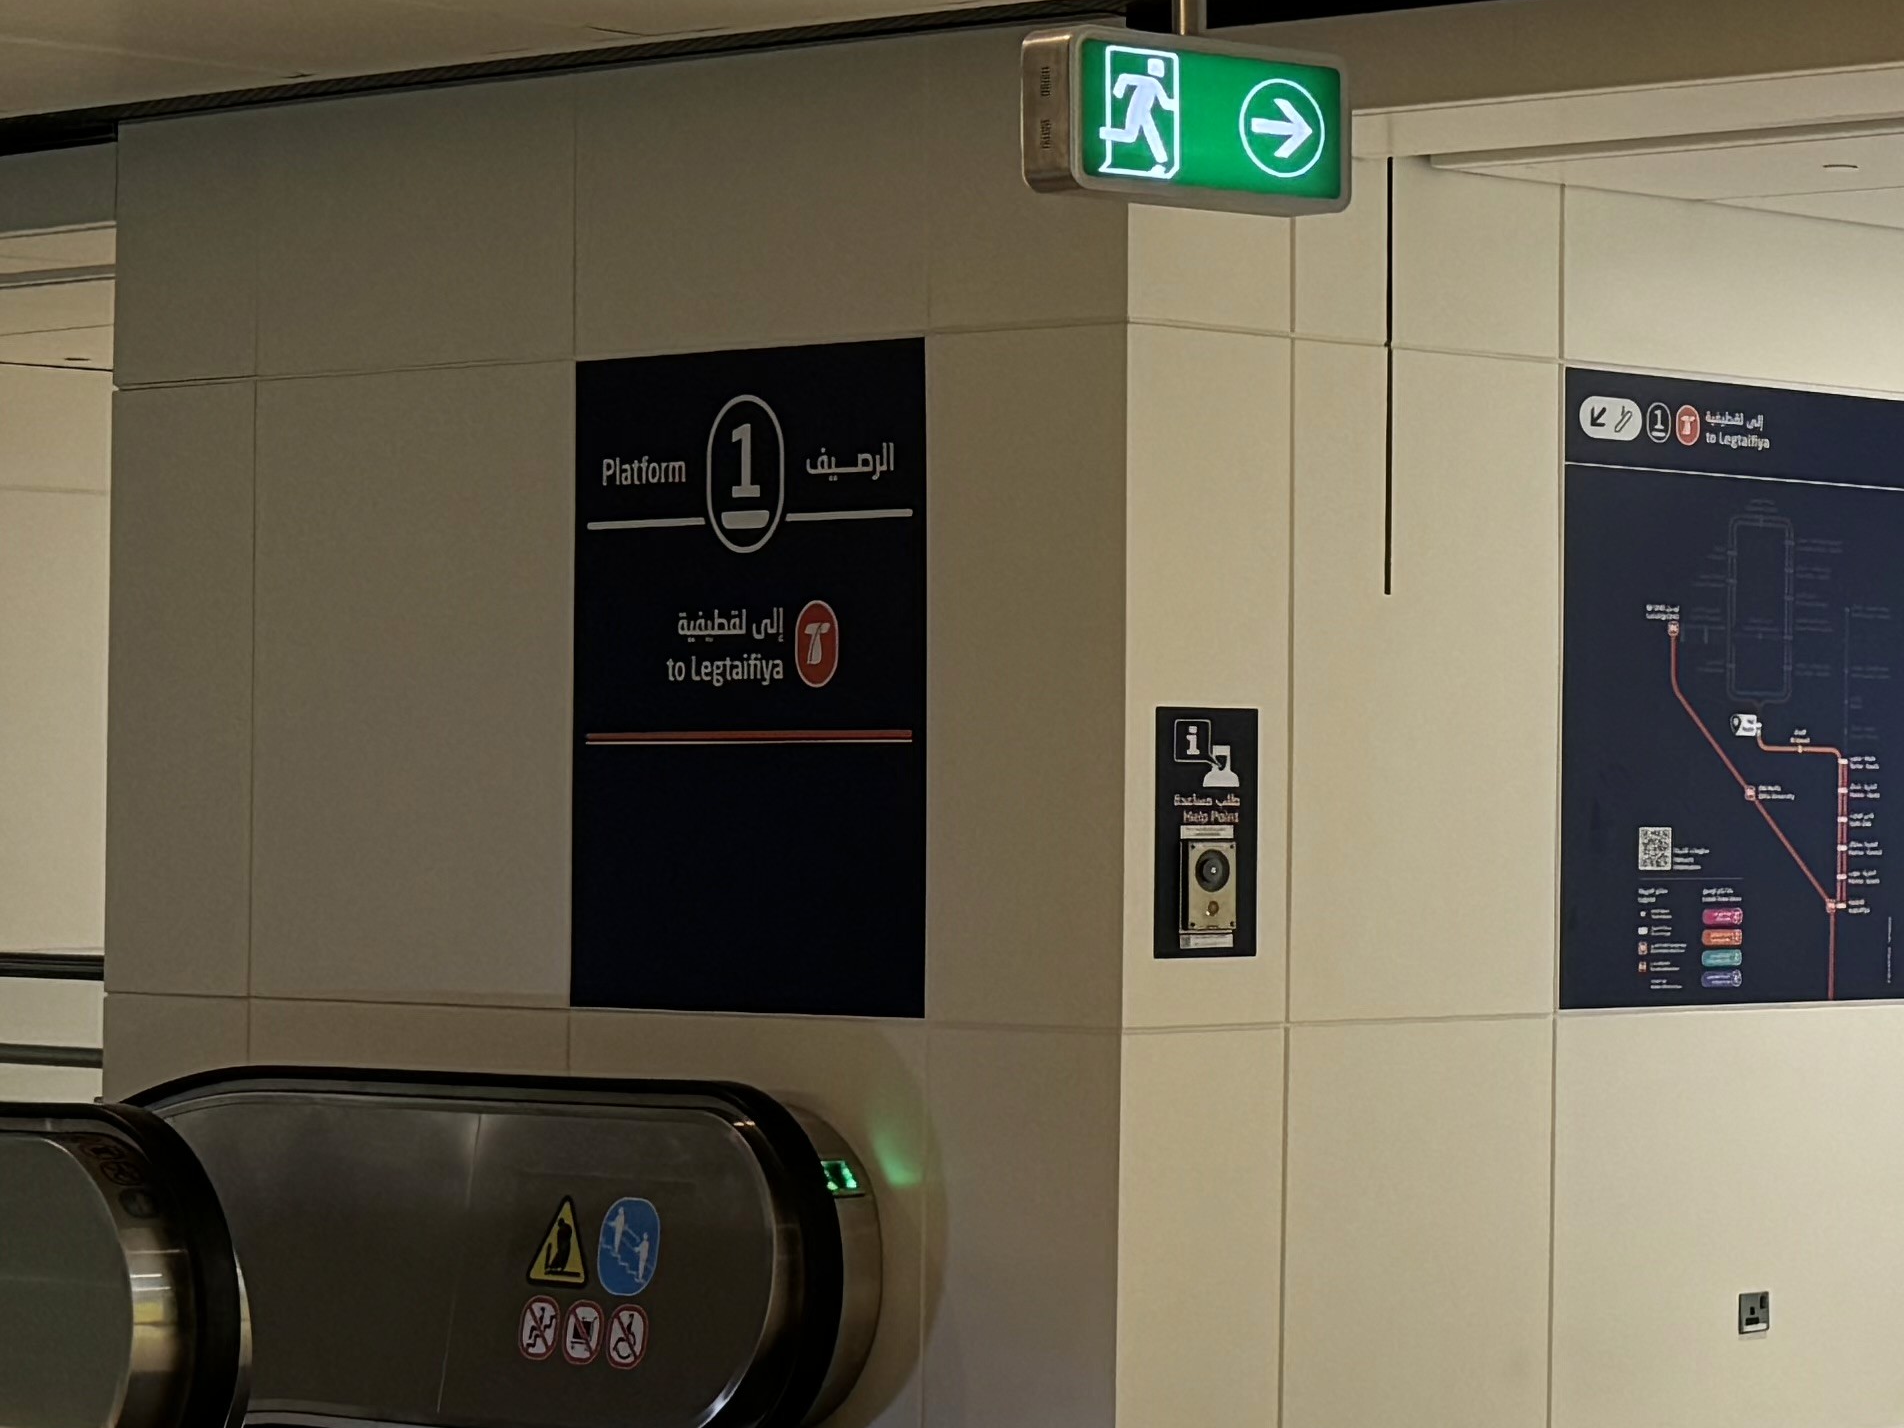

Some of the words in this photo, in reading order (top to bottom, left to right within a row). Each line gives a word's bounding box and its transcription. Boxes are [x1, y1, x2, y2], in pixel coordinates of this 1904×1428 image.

[1706, 433, 1716, 443] to
[1719, 430, 1769, 450] Legtaifiya
[603, 456, 685, 486] Platform
[732, 424, 760, 498] 1
[806, 443, 894, 481] الرصيف
[678, 609, 746, 642] لقطيفية
[753, 607, 783, 642] إلى
[667, 659, 685, 681] to
[692, 653, 783, 686] Legtaifiya
[1184, 811, 1208, 823] Help
[1211, 811, 1239, 822] Point
